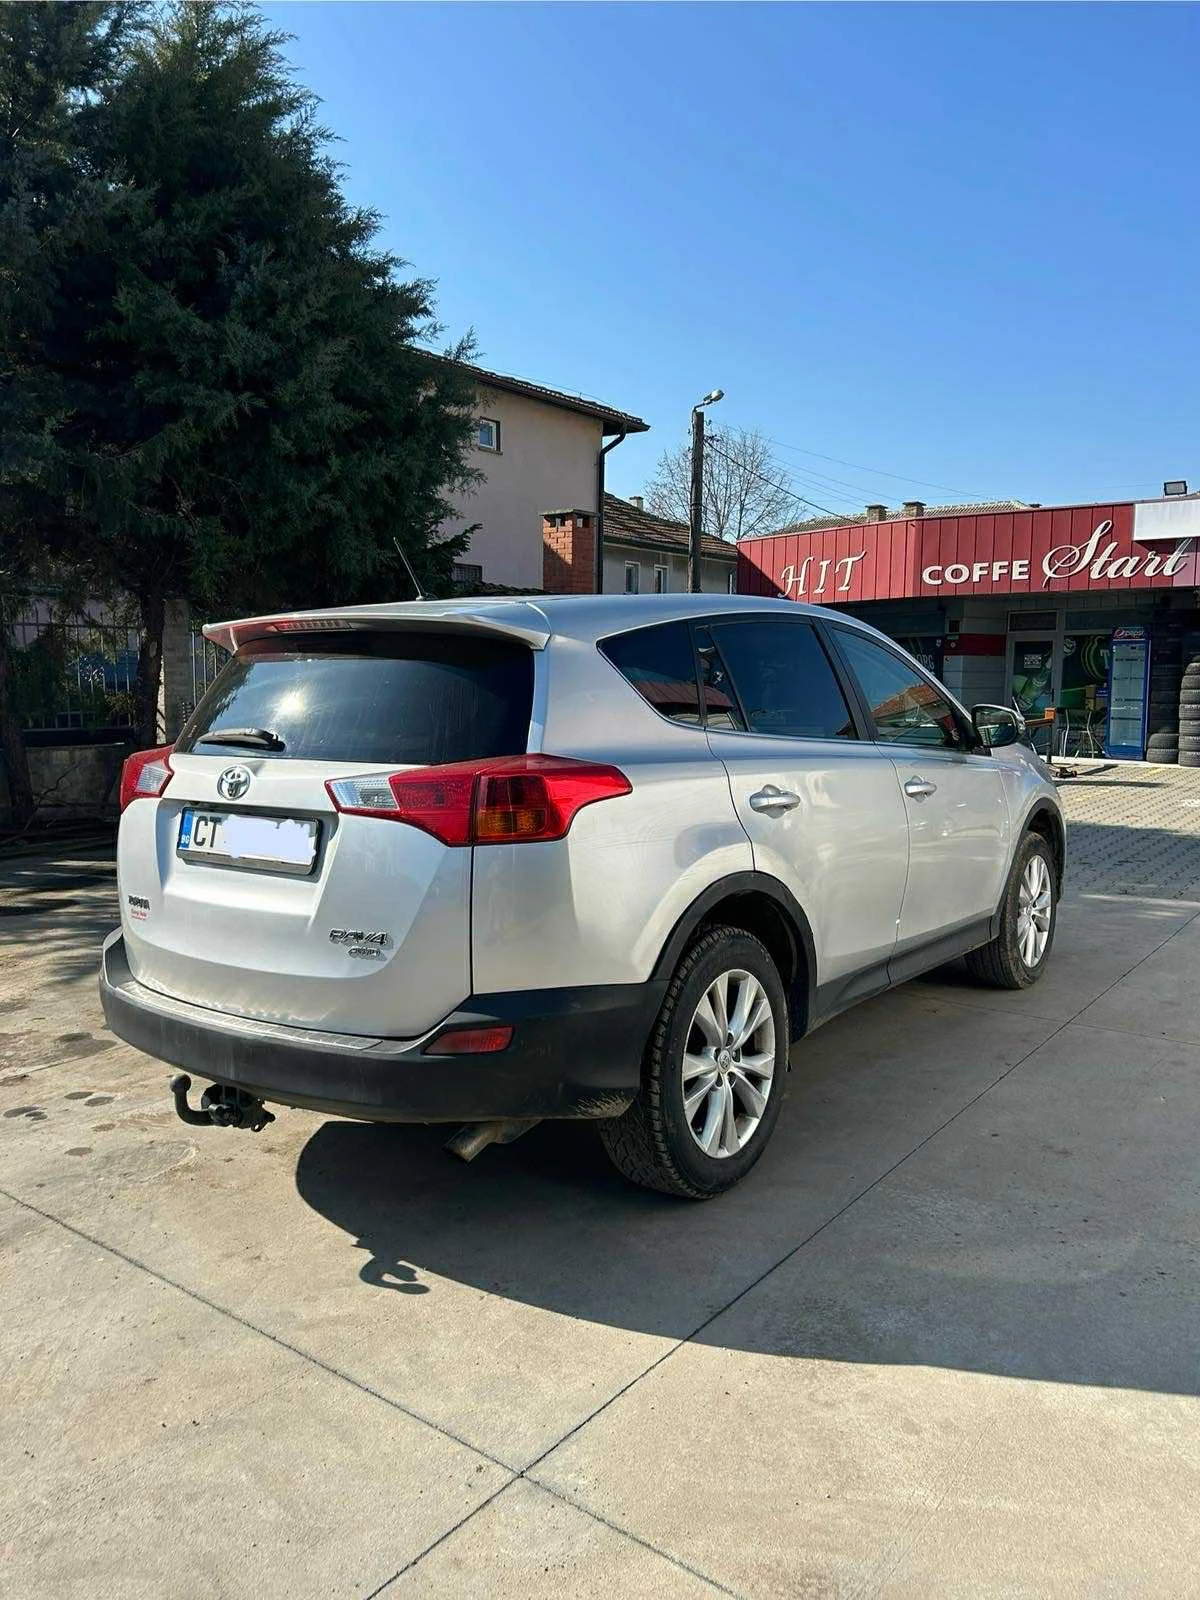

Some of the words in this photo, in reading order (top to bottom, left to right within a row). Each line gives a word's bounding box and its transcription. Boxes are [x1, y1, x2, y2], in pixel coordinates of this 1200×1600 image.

[778, 549, 868, 597] HIT
[921, 559, 1030, 585] COFFE
[1041, 519, 1193, 588] Start
[193, 815, 223, 848] CT
[329, 929, 388, 945] RAV4
